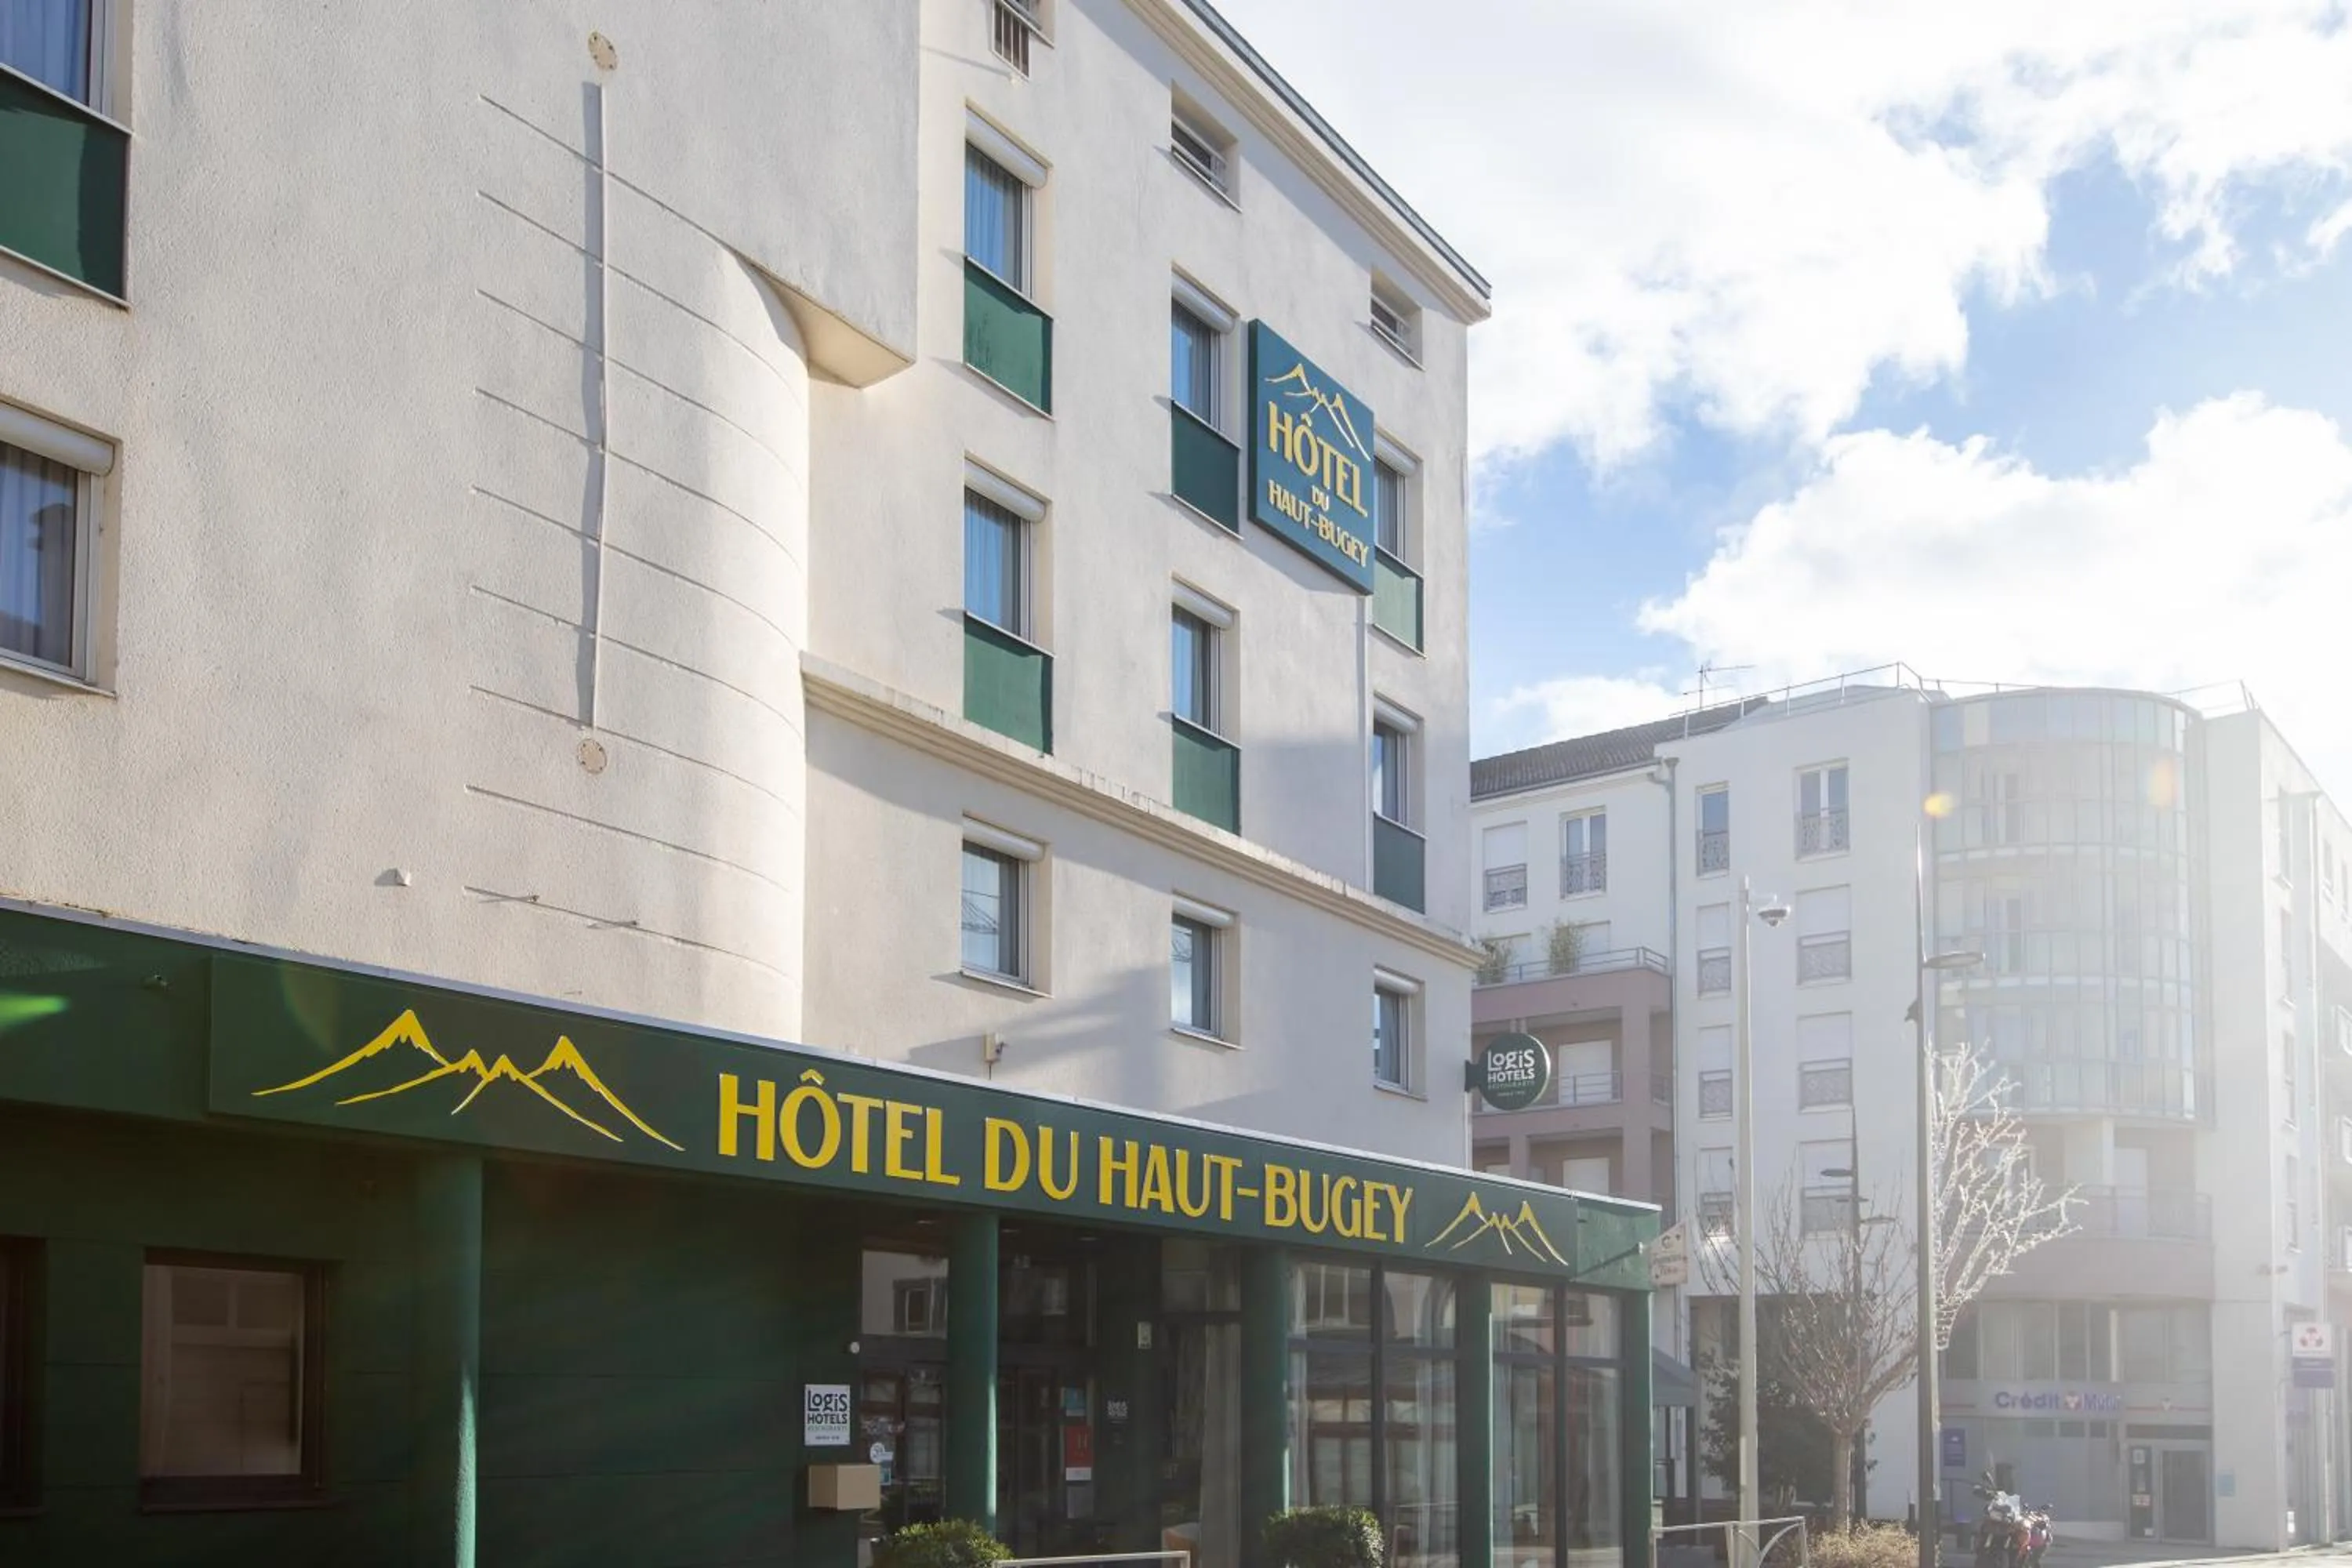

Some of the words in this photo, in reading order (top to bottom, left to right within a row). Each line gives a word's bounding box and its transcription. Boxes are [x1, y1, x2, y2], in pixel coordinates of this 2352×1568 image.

[1268, 401, 1368, 517] HÔTEL
[1268, 479, 1369, 568] HAUT-BUGEY
[1311, 485, 1330, 511] DU
[1487, 1067, 1536, 1083] HOTELS
[717, 1068, 961, 1186] HÔTEL
[984, 1116, 1080, 1200] DU
[1098, 1134, 1414, 1245] HAUT-BUGEY
[808, 1413, 848, 1425] HOTELS
